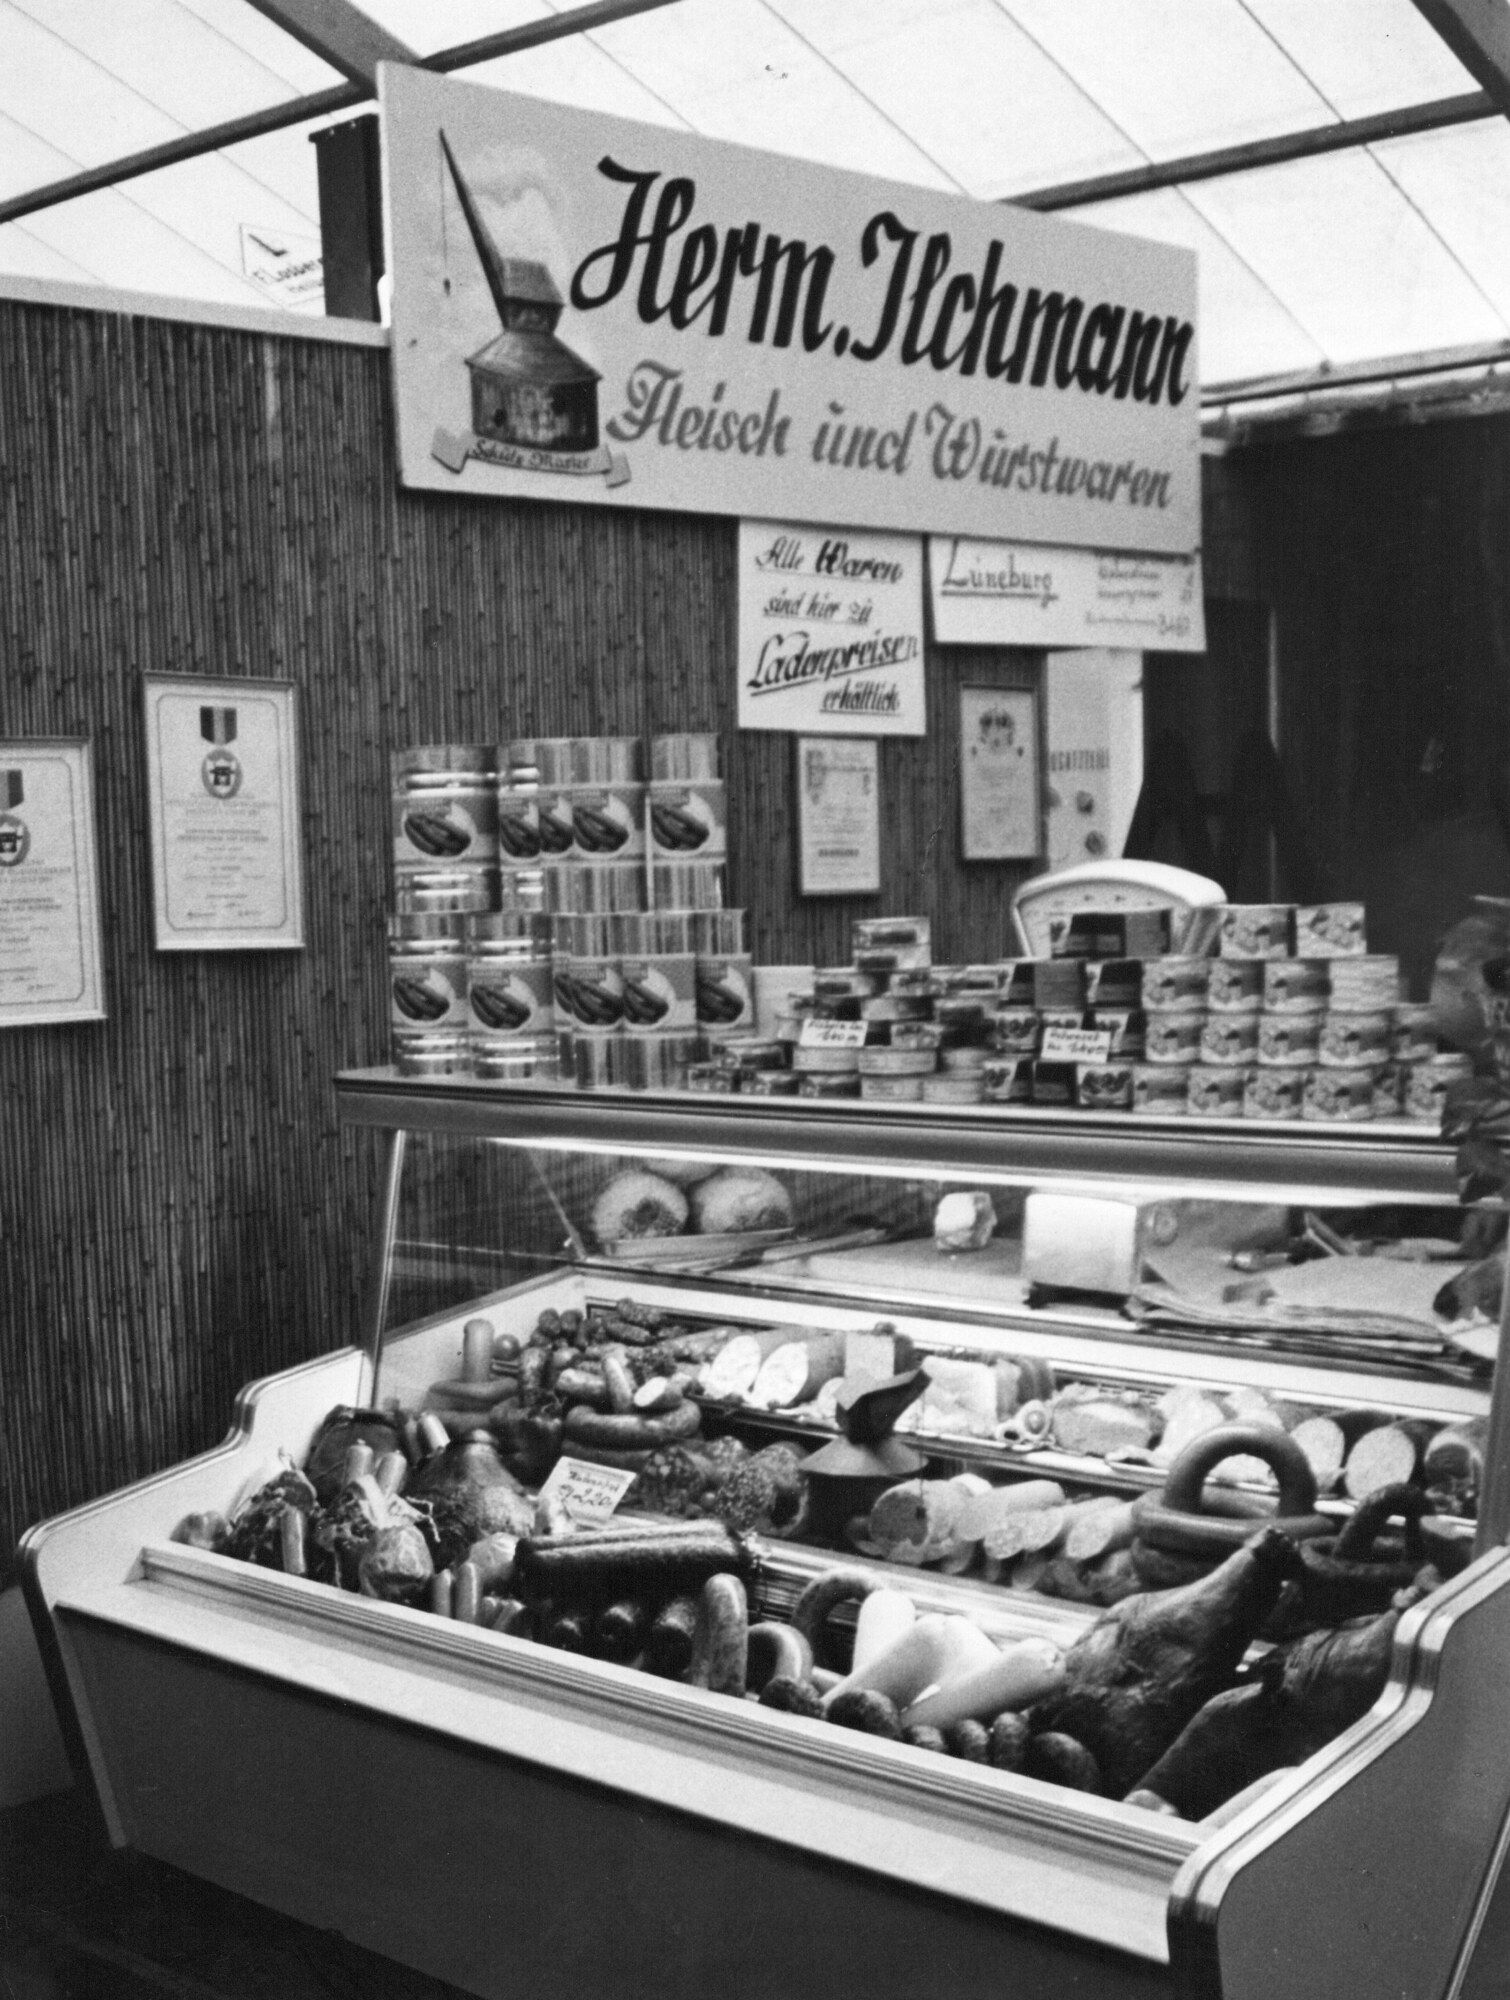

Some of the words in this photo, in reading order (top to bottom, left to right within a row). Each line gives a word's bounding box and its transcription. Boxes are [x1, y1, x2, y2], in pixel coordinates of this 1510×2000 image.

[570, 154, 850, 358] Herm.
[850, 210, 1192, 407] Ilchmann
[605, 358, 793, 458] Fleisch
[755, 535, 804, 571] Alle
[815, 539, 903, 583] Waren
[763, 586, 806, 618] sind
[807, 592, 840, 620] hier
[747, 628, 918, 689] Ladenpreisen
[822, 678, 900, 712] erhältlich
